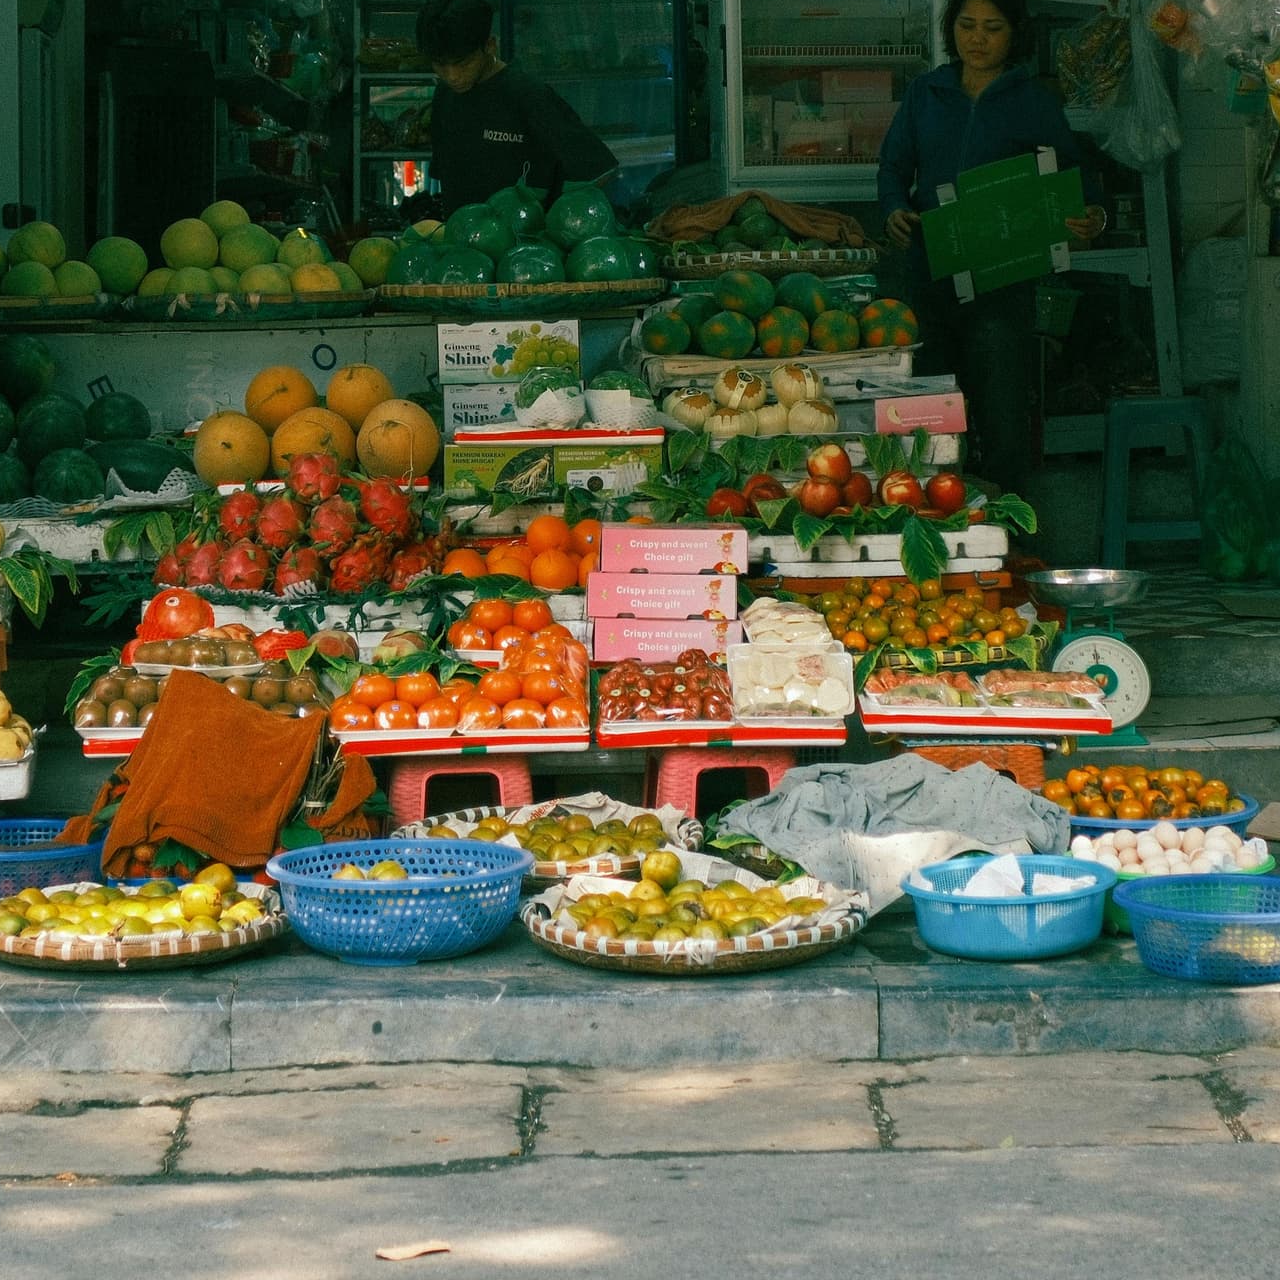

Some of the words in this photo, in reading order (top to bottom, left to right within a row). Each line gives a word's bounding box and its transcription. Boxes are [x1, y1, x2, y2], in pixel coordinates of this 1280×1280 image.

[444, 343, 481, 352] Ginseng
[445, 353, 490, 365] Shine
[452, 402, 489, 411] Ginseng
[453, 411, 498, 424] Shine
[630, 540, 659, 549] Crispy
[644, 553, 675, 561] Choice
[677, 553, 694, 562] gift
[616, 586, 646, 596] Crispy
[648, 587, 665, 595] and
[631, 600, 662, 608] Choice
[664, 600, 681, 609] gift
[623, 630, 653, 639] Crispy
[674, 631, 702, 639] sweet
[638, 642, 670, 651] Choice
